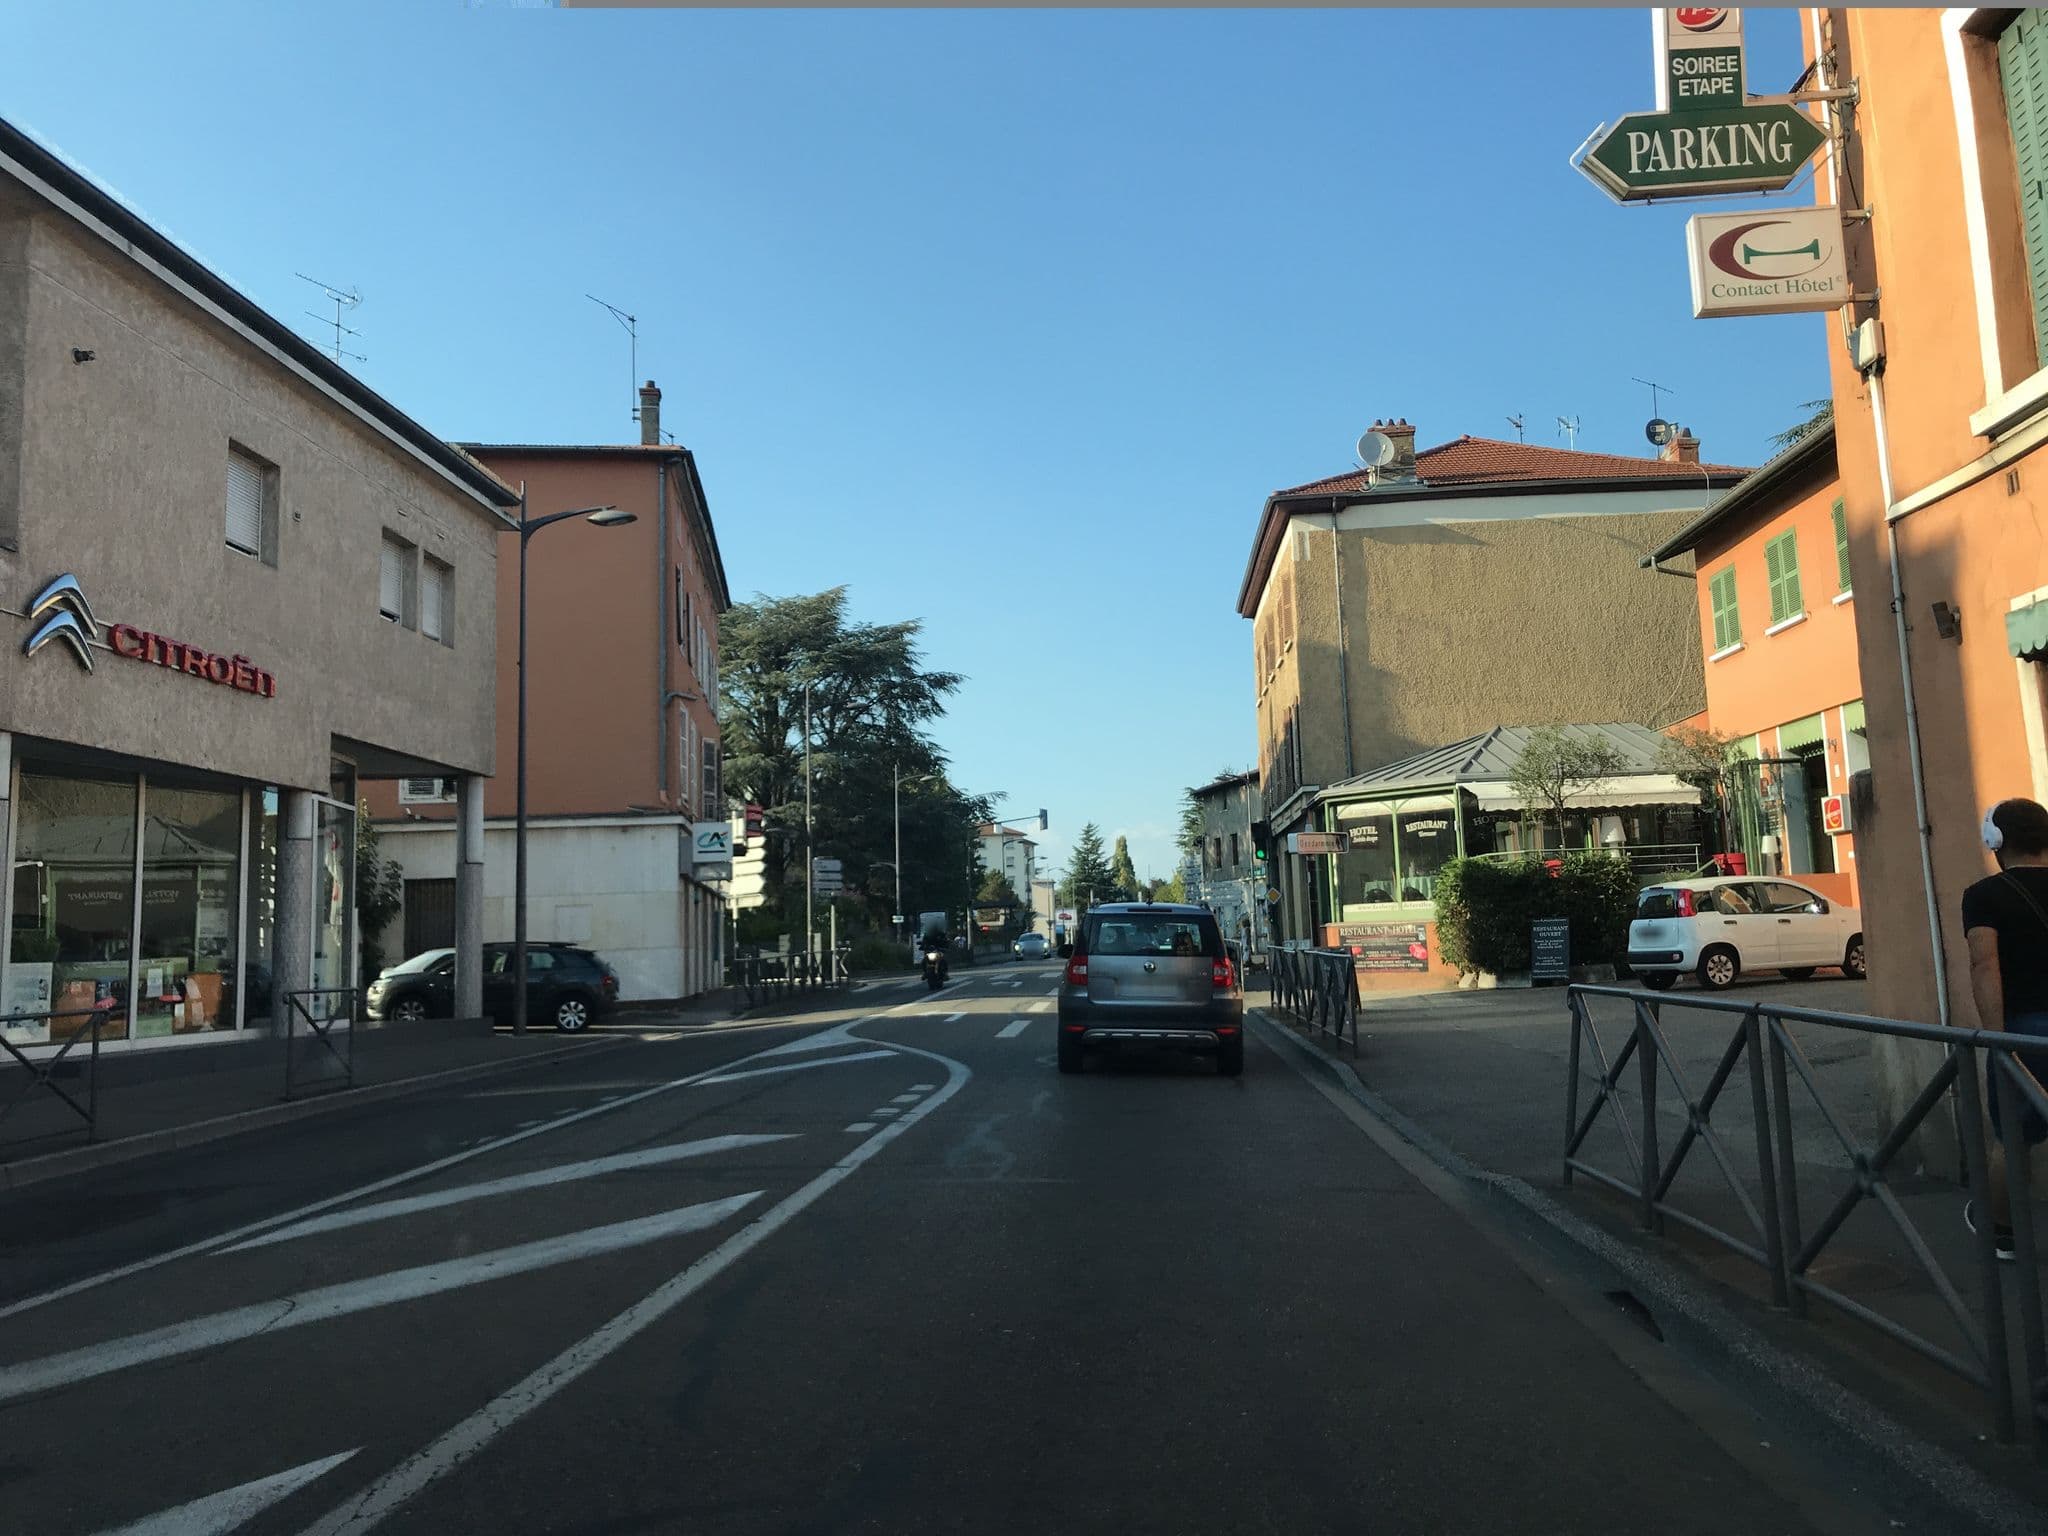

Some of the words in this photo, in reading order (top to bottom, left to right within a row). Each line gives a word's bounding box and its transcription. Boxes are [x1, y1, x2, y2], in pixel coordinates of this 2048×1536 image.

[1672, 55, 1739, 75] SOIREE
[1678, 77, 1734, 96] ETAPE
[1626, 120, 1793, 174] PARKING
[1711, 281, 1780, 298] Contact
[1785, 277, 1834, 294] Hôtel
[1349, 826, 1378, 838] HOTEL
[1405, 820, 1448, 833] RESTAURANT
[1340, 926, 1388, 937] RESTAURANT
